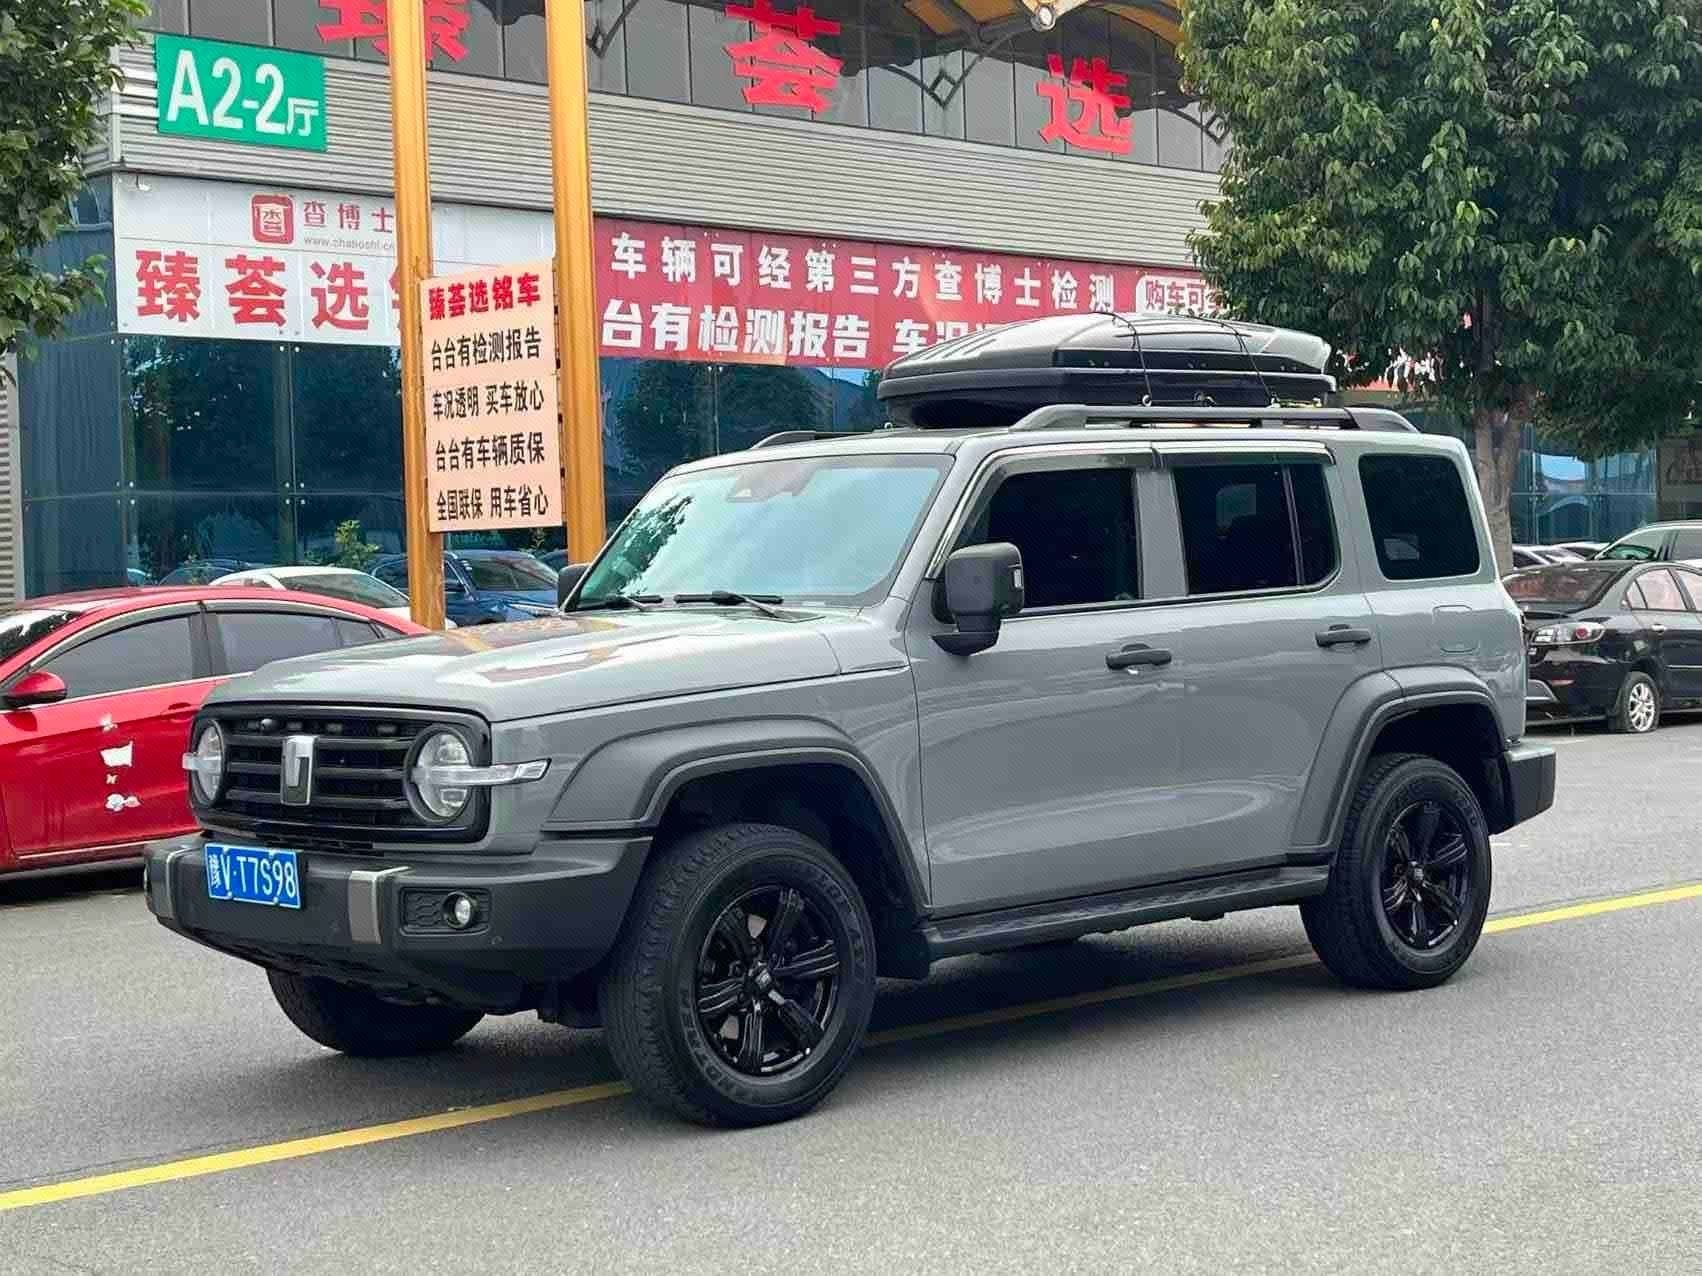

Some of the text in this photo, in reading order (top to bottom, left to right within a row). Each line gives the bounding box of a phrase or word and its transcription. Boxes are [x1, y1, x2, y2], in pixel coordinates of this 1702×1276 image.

[167, 49, 319, 136] A2-2厅
[304, 201, 394, 233] 查博士
[136, 250, 400, 331] 臻荟选
[611, 231, 1115, 312] 车辆可经第三方查博士检测
[428, 272, 541, 321] 臻荟选铭车
[431, 325, 542, 372] 台台有检测报告
[432, 379, 545, 420] 车况透明 买车放心
[435, 431, 545, 472] 台台有车辆质保
[437, 484, 549, 521] 全国联保 用车省心
